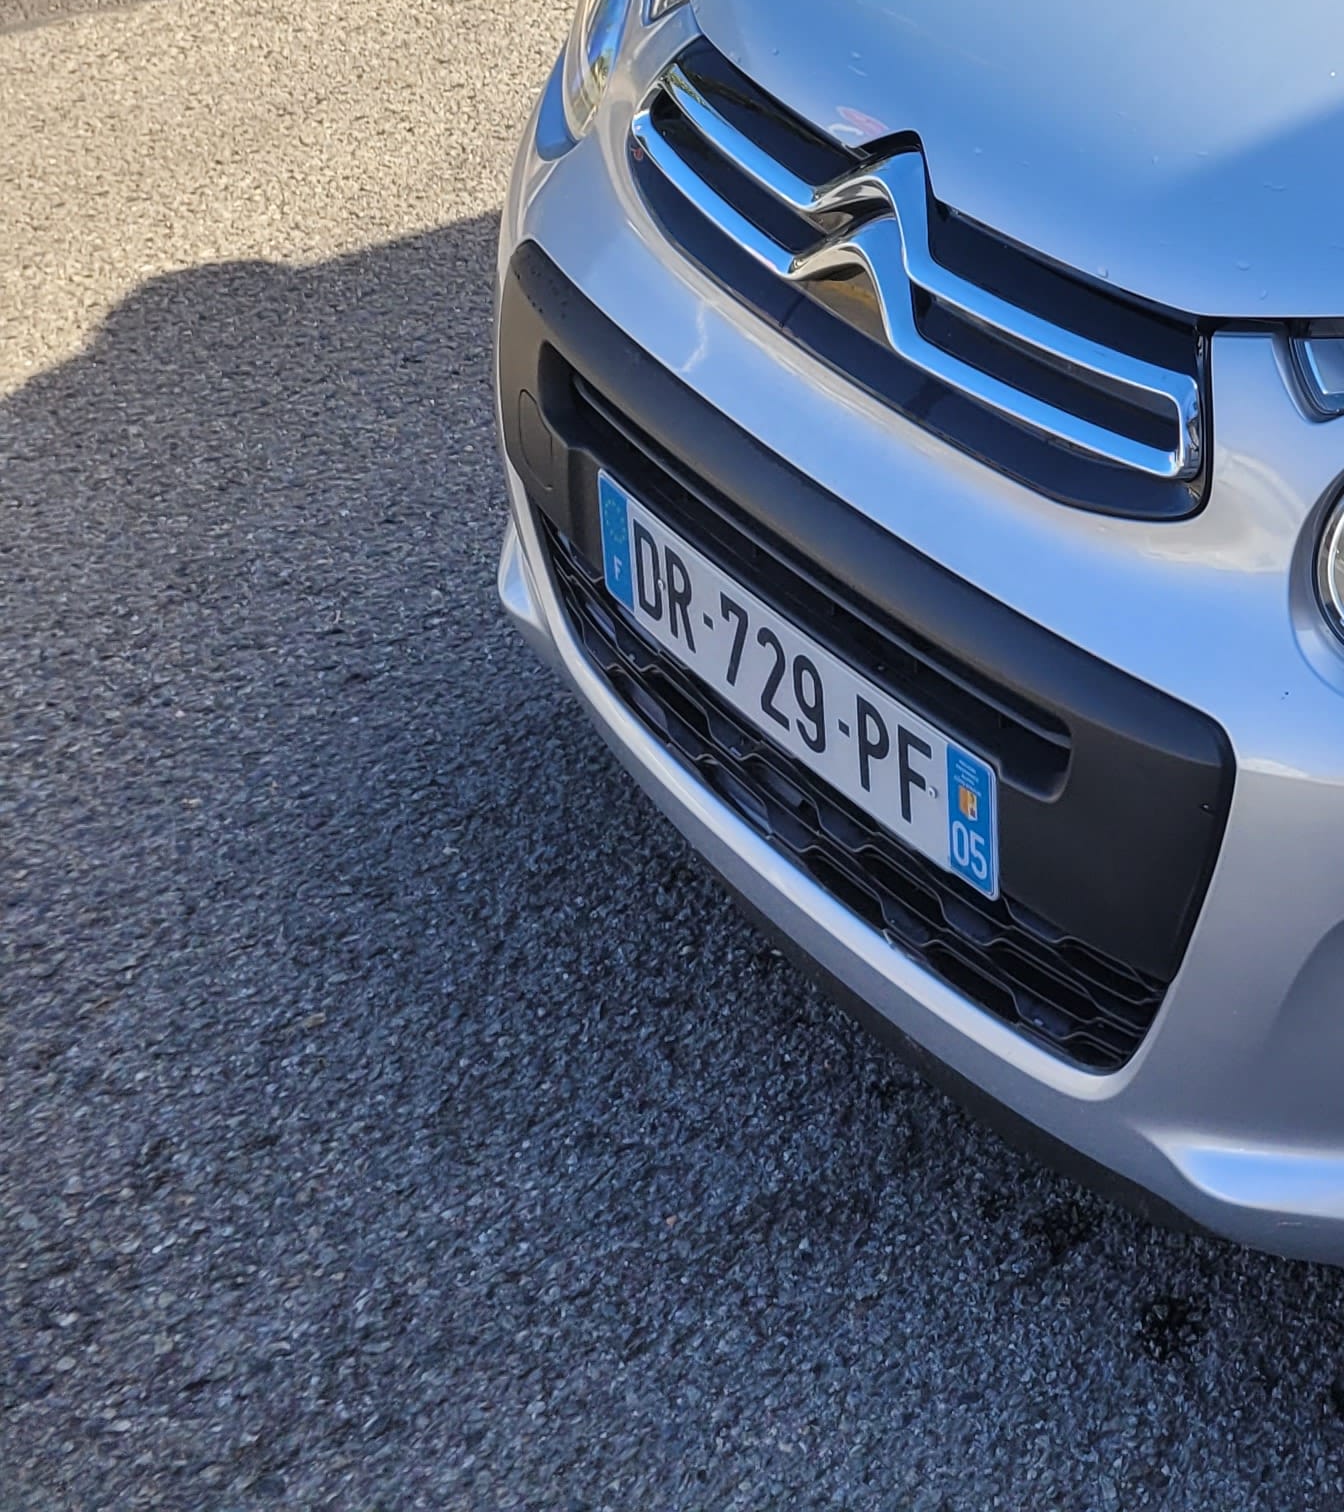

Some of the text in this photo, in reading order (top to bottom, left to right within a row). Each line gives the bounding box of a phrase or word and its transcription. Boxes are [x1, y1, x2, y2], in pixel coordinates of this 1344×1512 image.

[613, 554, 622, 581] F
[633, 518, 933, 824] DR-729-PF
[952, 820, 988, 880] 05
